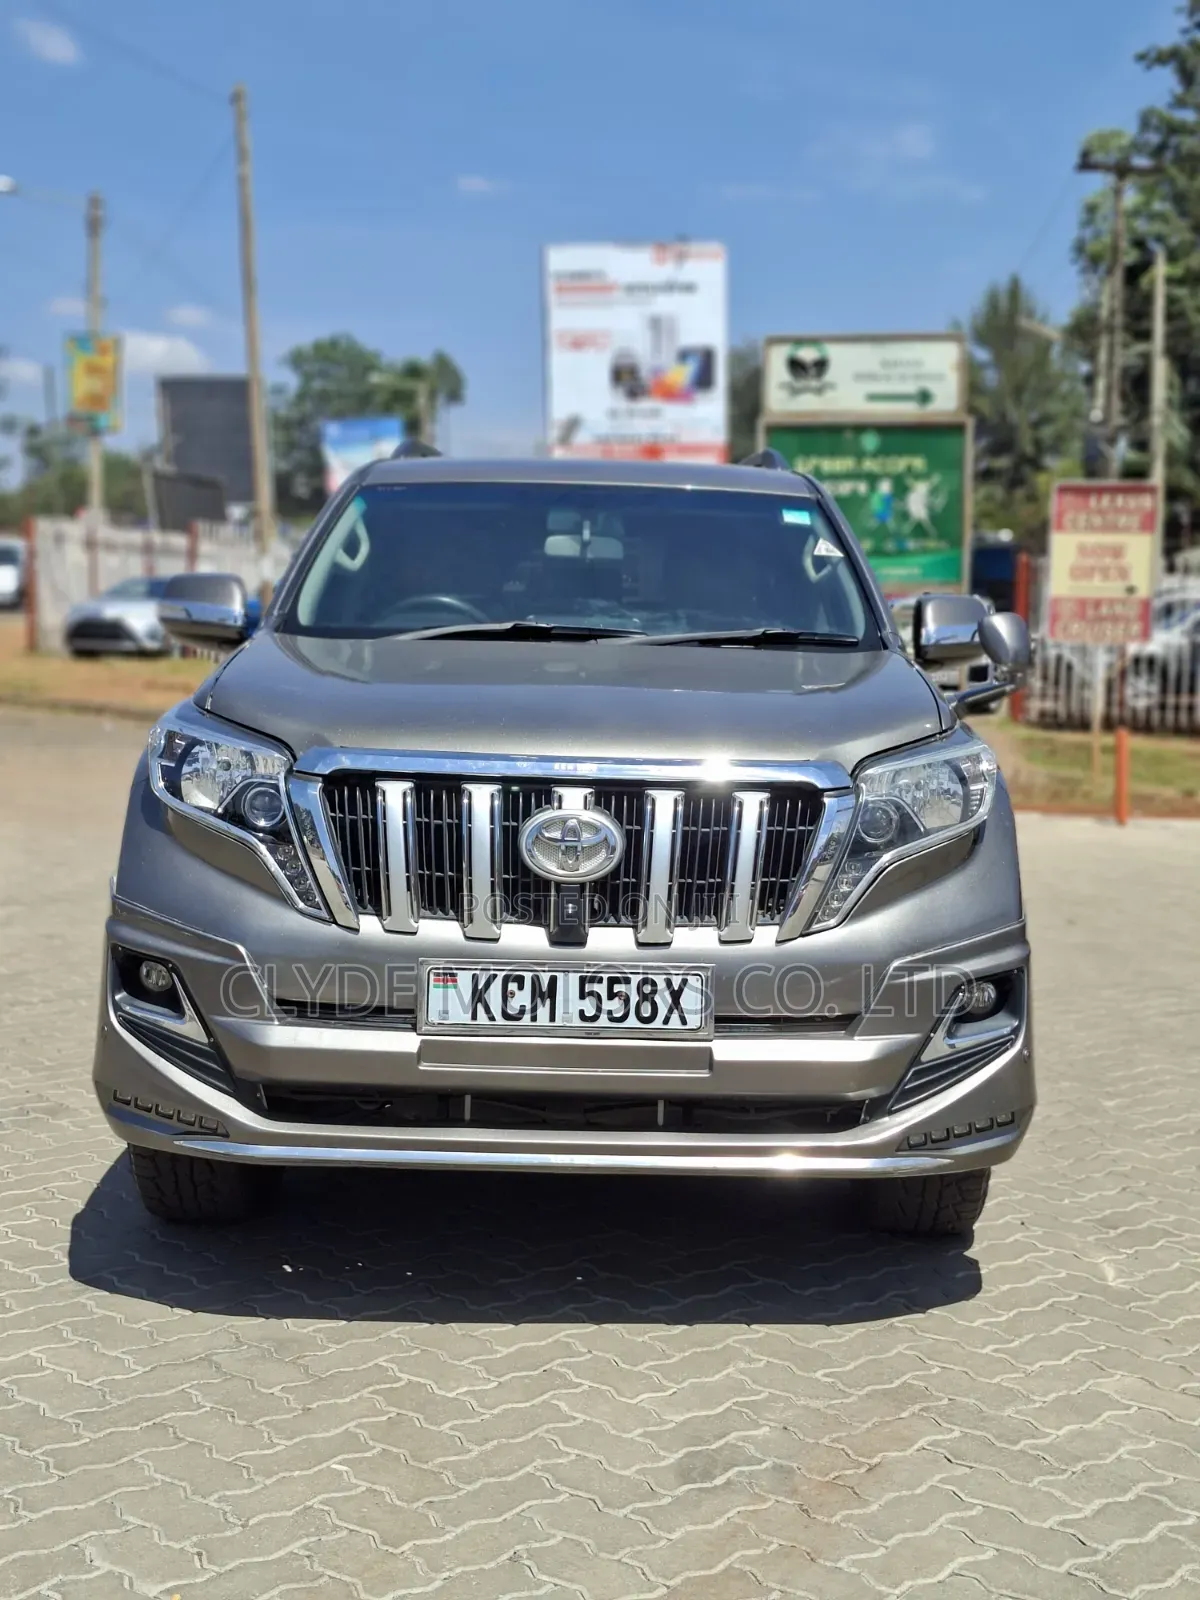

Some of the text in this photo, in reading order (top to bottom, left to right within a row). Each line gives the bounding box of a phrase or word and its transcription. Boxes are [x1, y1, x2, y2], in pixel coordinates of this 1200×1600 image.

[1064, 511, 1142, 528] CENTRE
[1069, 564, 1131, 582] OPEN
[470, 972, 689, 1026] KCM 558X
